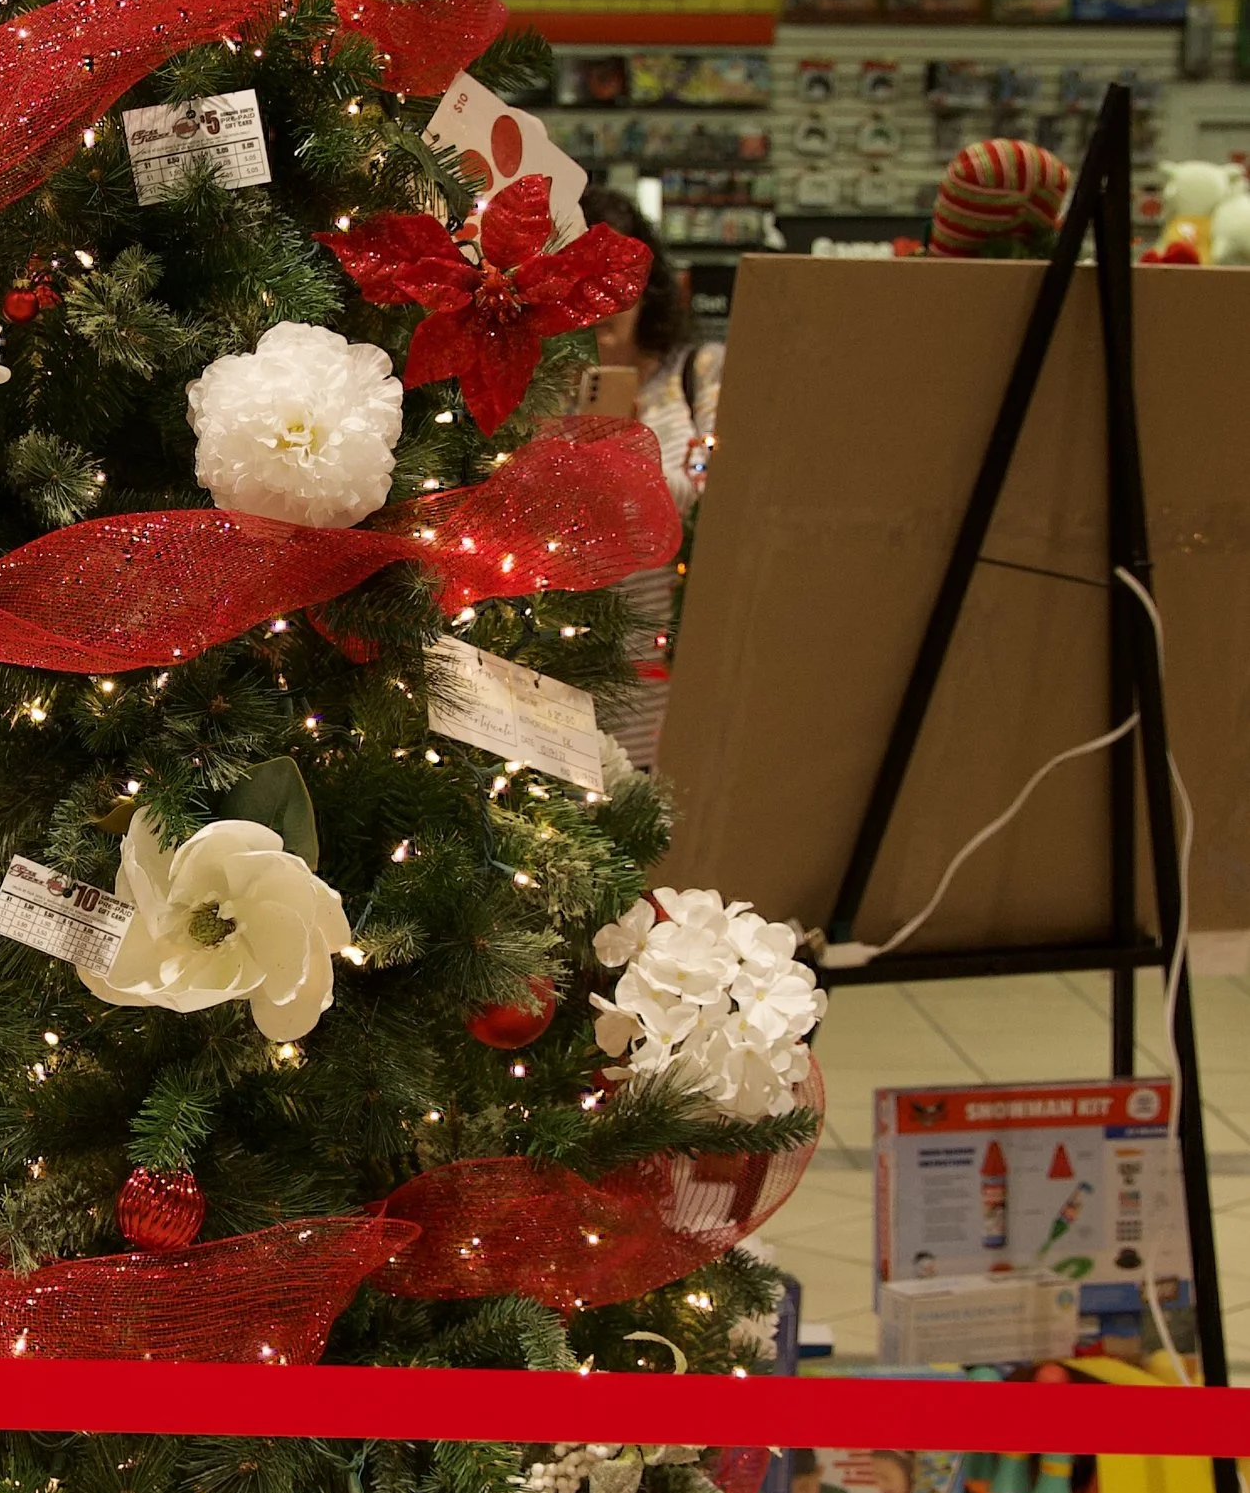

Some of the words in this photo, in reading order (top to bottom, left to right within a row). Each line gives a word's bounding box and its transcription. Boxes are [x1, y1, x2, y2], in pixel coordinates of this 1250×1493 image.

[453, 92, 468, 114] $10
[98, 899, 132, 917] PRE-PAID
[963, 1096, 1074, 1121] SNOWMAN
[1076, 1095, 1114, 1117] KIT
